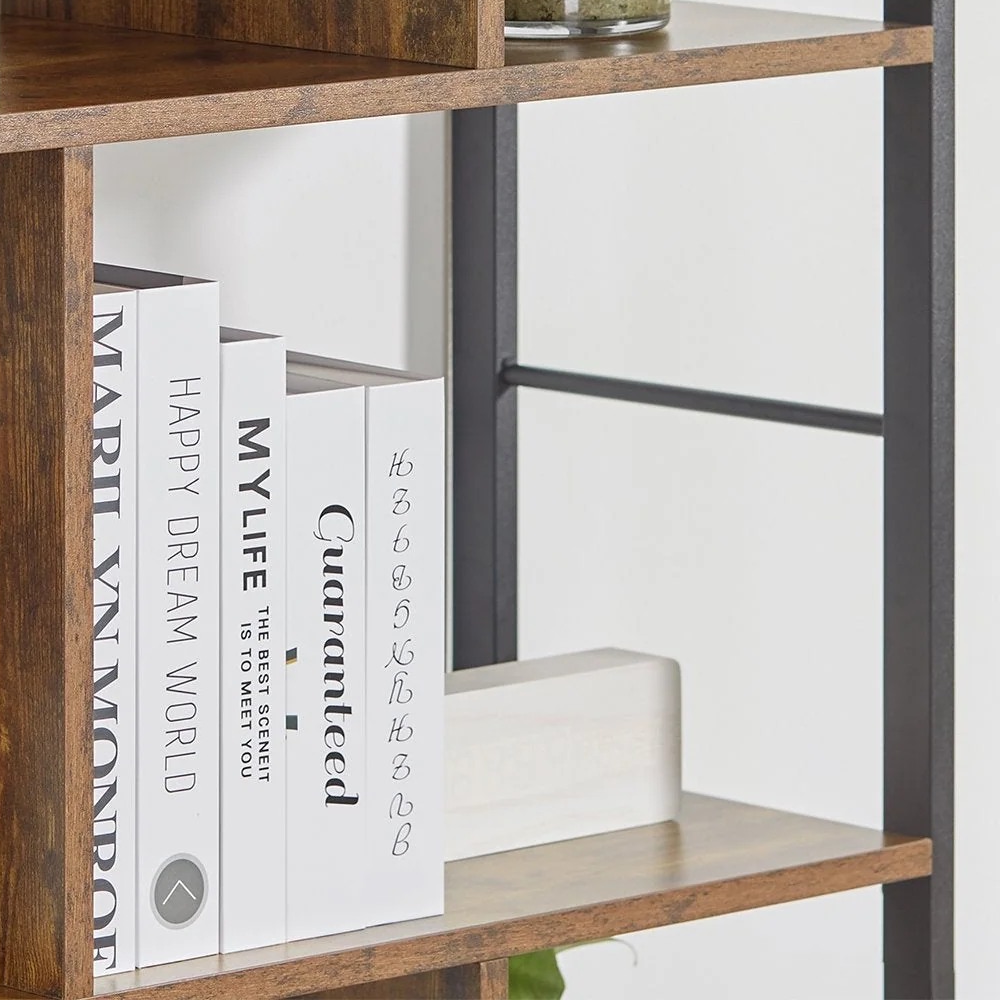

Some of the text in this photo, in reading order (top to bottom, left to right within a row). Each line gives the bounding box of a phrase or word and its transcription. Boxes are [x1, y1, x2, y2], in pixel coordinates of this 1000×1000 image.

[164, 377, 201, 794] HAPPY DREAM WORLD
[240, 622, 252, 779] IS TO MEET YOU
[258, 605, 270, 783] THE BEST SCENEIT
[312, 503, 360, 808] Guaranteed
